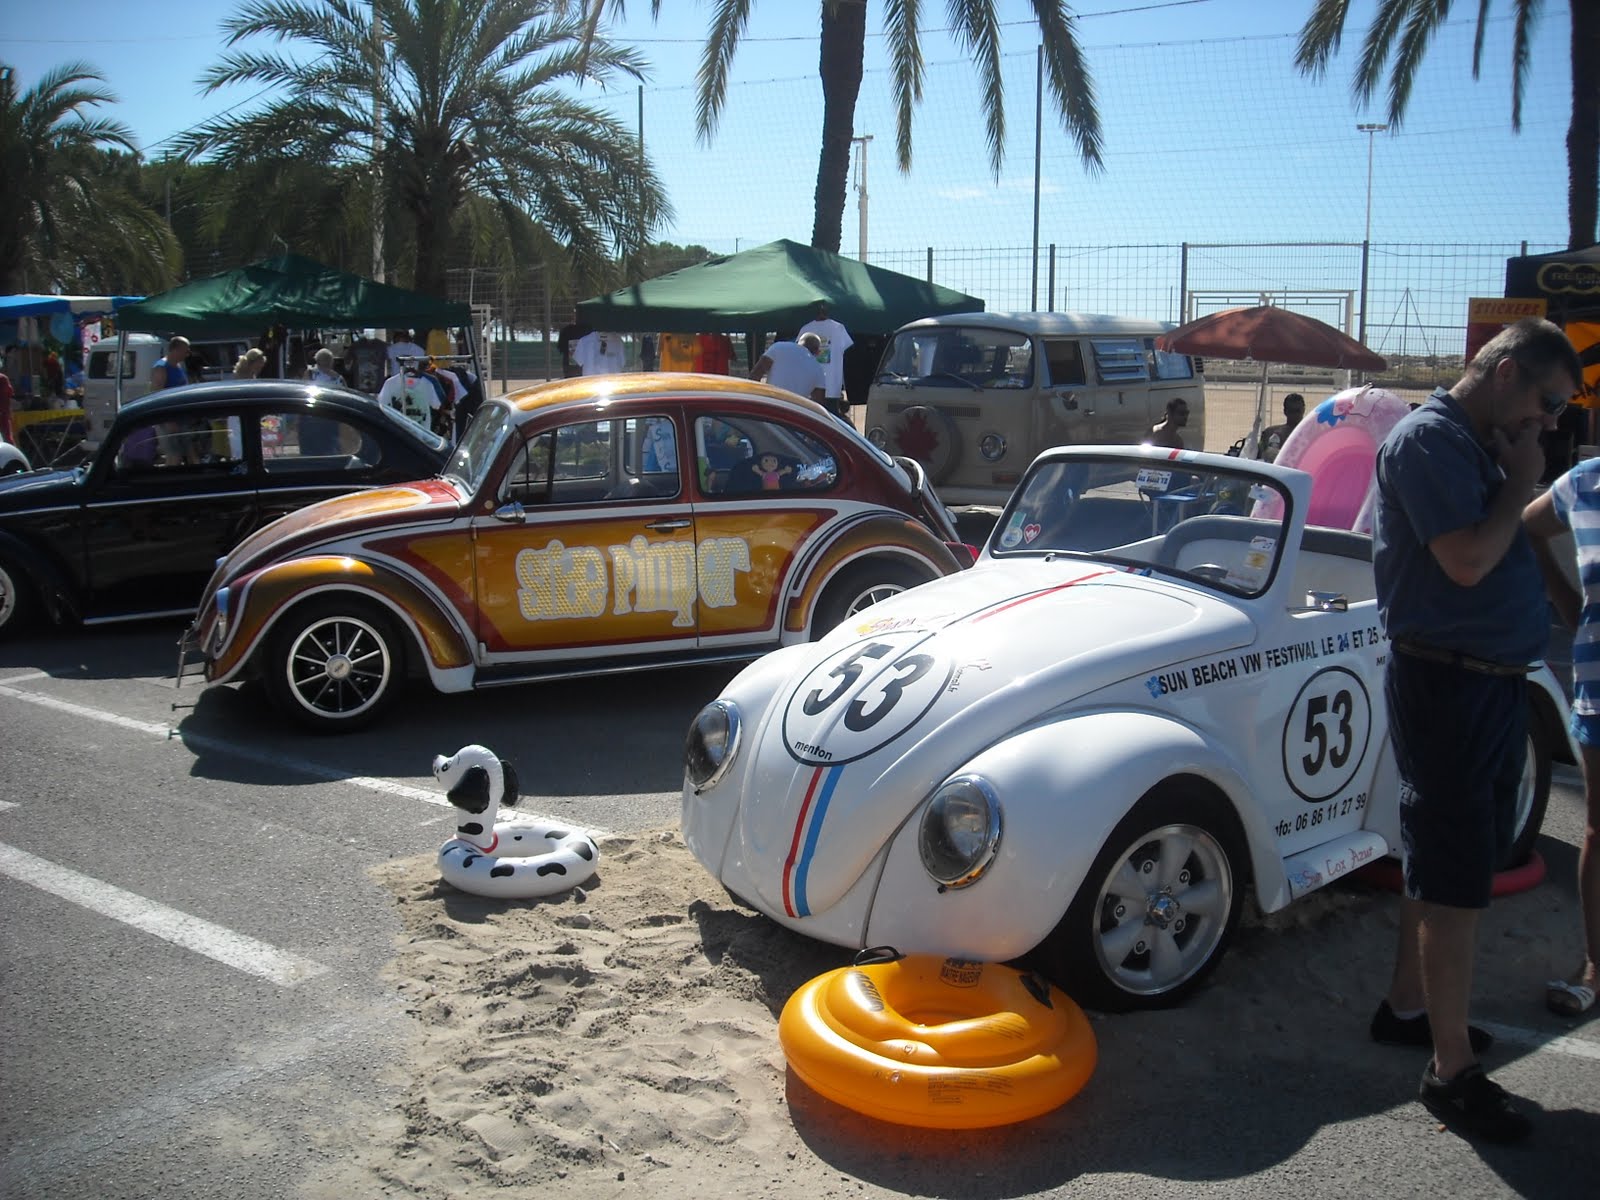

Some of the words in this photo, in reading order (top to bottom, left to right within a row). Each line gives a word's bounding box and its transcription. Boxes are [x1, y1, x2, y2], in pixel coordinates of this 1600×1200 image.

[1474, 303, 1541, 316] STICKERS
[1158, 670, 1188, 695] SUN
[1191, 659, 1238, 687] BEACH
[1241, 653, 1262, 675] VW
[1266, 643, 1318, 669] FESTIVAL
[1321, 636, 1336, 656] LE
[1337, 632, 1350, 651] 24
[1352, 630, 1365, 649] ET
[1367, 626, 1379, 645] 25
[803, 642, 936, 732] 53
[1302, 689, 1353, 776] 53
[794, 741, 833, 761] menton
[1295, 813, 1309, 831] 06
[1311, 807, 1324, 826] 86
[1327, 802, 1338, 820] 11
[1341, 797, 1354, 816] 27
[1326, 859, 1347, 877] Cox
[1348, 846, 1374, 868] Azur
